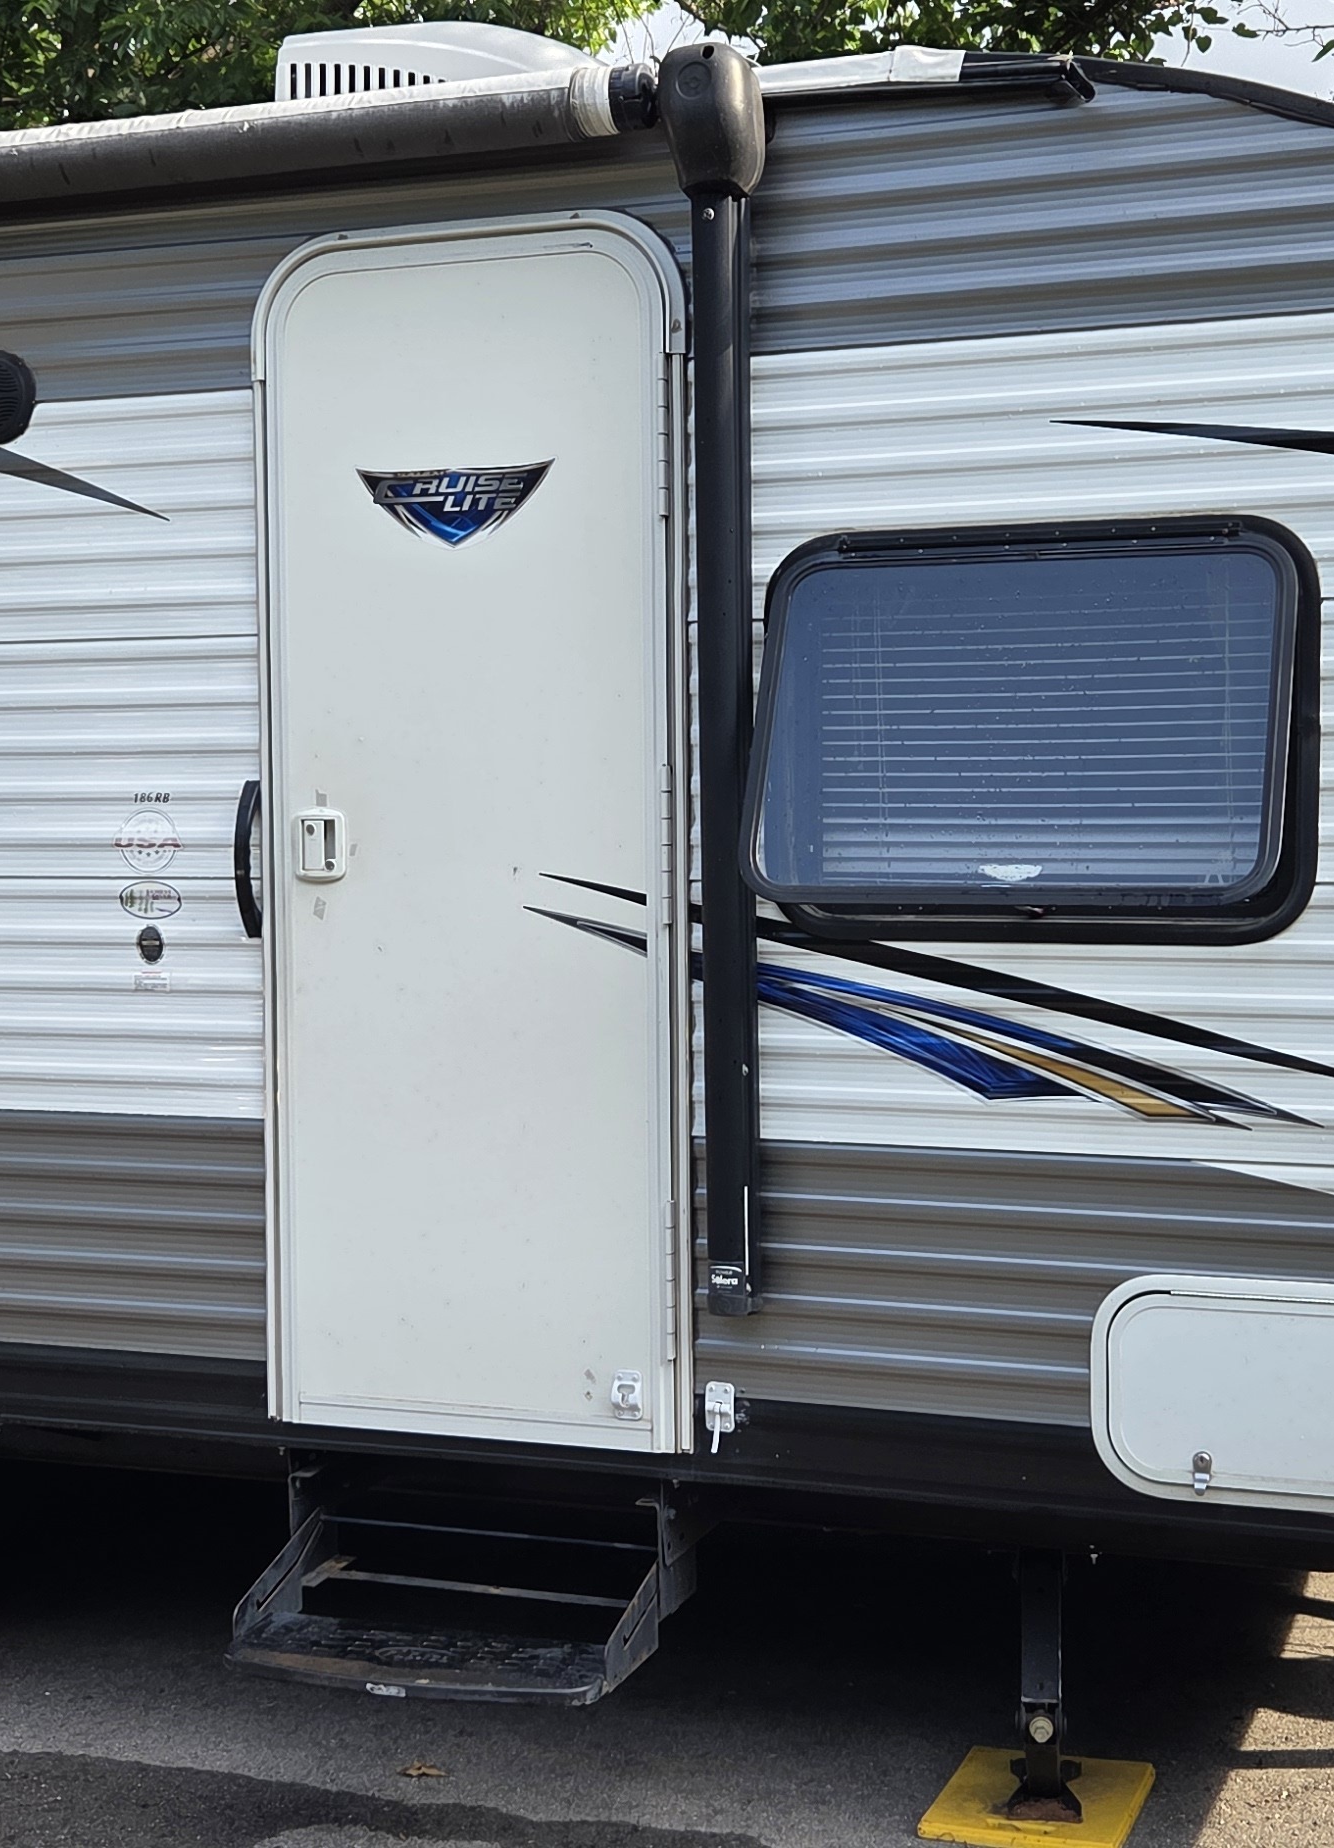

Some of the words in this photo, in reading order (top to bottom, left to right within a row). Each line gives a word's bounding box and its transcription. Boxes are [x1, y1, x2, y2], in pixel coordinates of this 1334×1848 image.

[373, 473, 527, 504] CRUISE
[443, 492, 521, 513] LITE
[134, 792, 170, 803] 186RB
